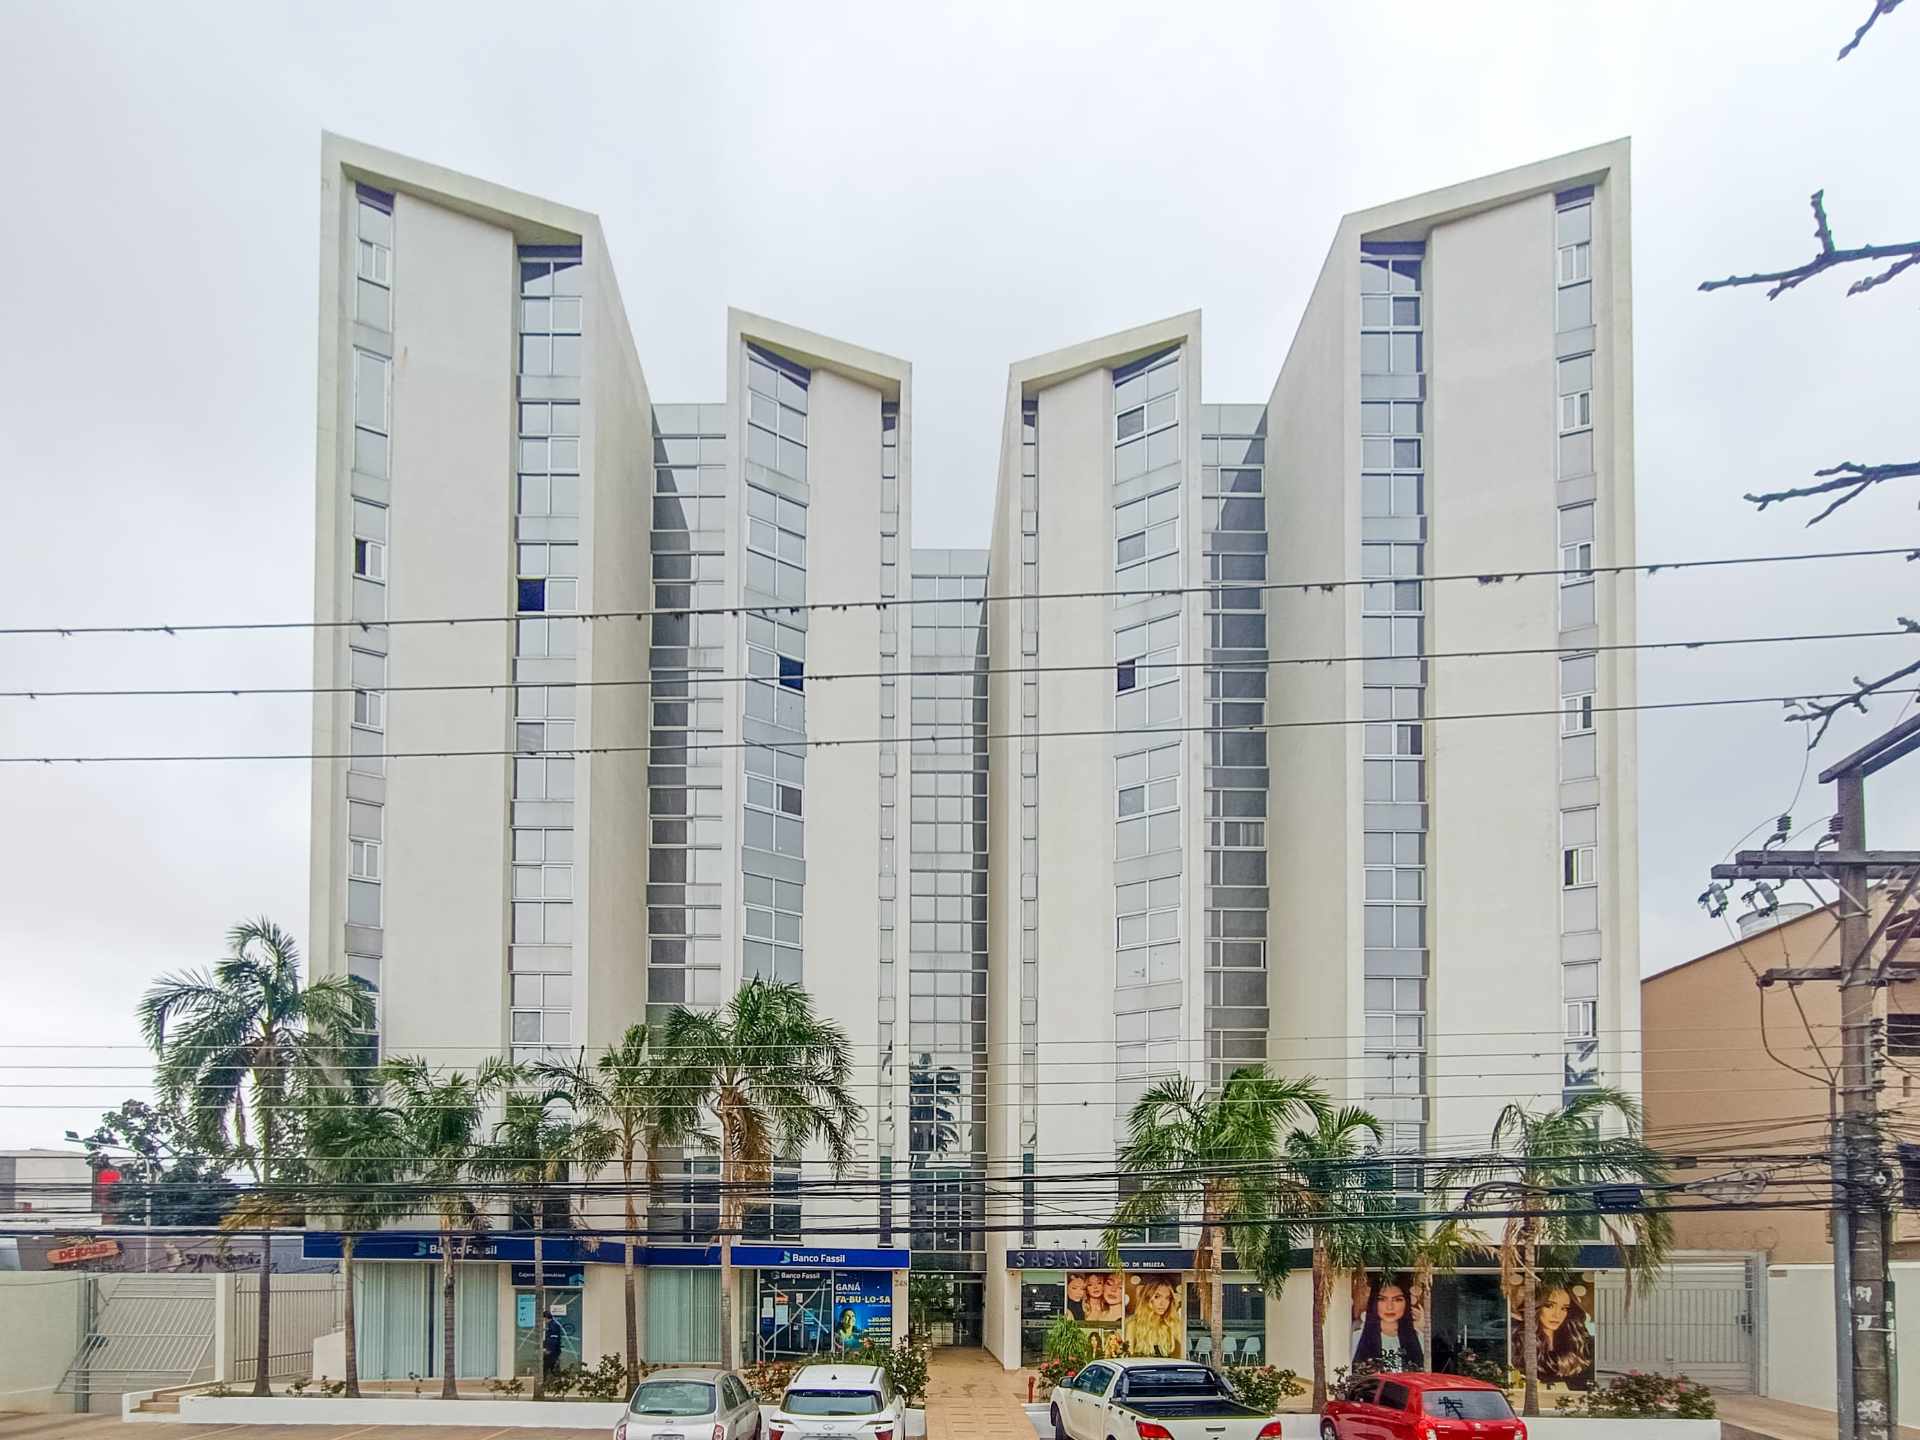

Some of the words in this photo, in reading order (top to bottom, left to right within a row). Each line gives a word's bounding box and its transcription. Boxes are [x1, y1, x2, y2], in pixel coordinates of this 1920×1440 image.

[429, 1244, 463, 1254] Baco
[466, 1245, 497, 1255] Fasil
[792, 1253, 819, 1262] Banco
[820, 1254, 846, 1263] Fassil
[1016, 1251, 1100, 1267] SABASH
[835, 1281, 861, 1291] GANÁ
